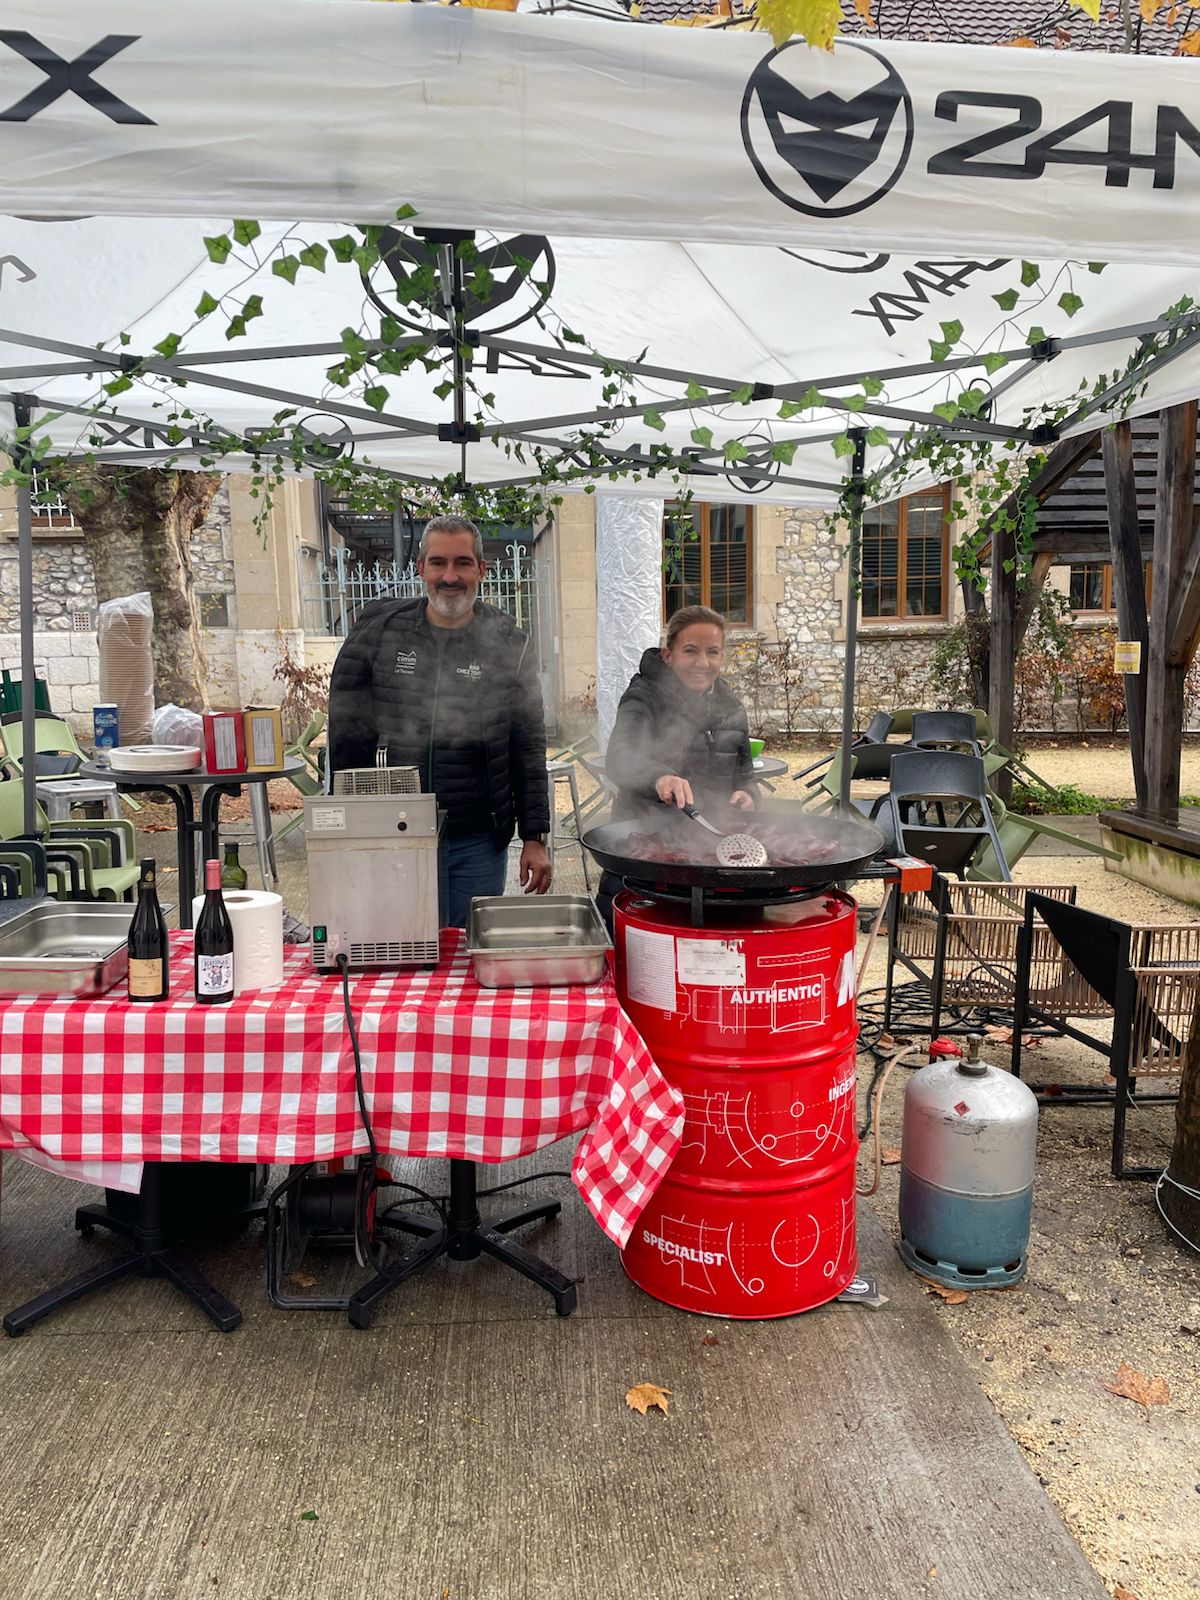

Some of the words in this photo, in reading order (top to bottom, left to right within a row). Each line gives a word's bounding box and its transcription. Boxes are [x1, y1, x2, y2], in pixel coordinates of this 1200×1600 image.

[0, 29, 159, 126] X
[730, 983, 822, 1004] AUTHENTIC
[643, 1230, 725, 1266] SPECIALIST
